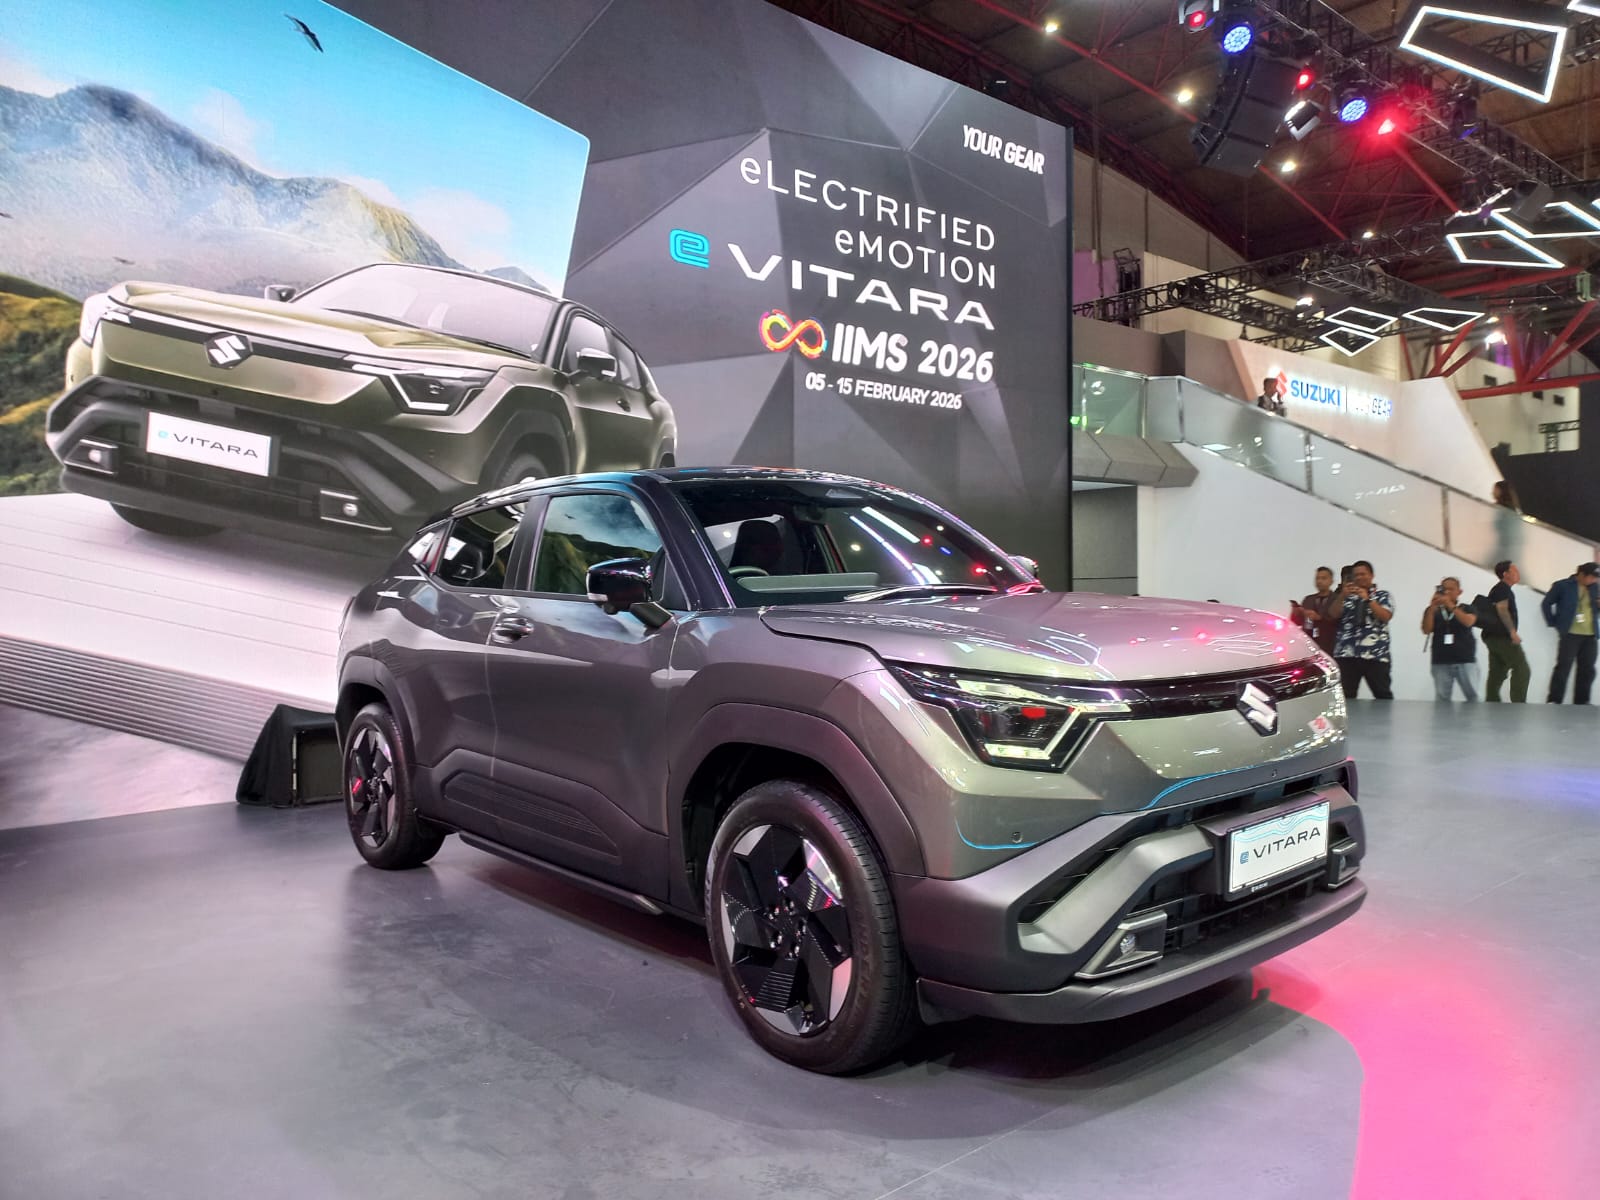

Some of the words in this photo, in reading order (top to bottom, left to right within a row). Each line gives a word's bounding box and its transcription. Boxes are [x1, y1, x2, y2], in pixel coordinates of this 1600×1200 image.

[963, 124, 1003, 160] YOUR
[1003, 141, 1045, 175] GEAR
[740, 157, 995, 251] eLECTRIFIED
[834, 229, 996, 290] eMOTION
[727, 243, 995, 331] VITARA
[831, 322, 909, 373] IIMS
[917, 340, 994, 383] 2026
[805, 372, 826, 391] 05
[836, 377, 852, 395] 15
[854, 379, 931, 405] FEBRUARY
[930, 390, 963, 410] 2026
[1290, 379, 1341, 407] SUZUKI
[173, 433, 258, 458] VITARA
[1253, 826, 1321, 858] VITARA
